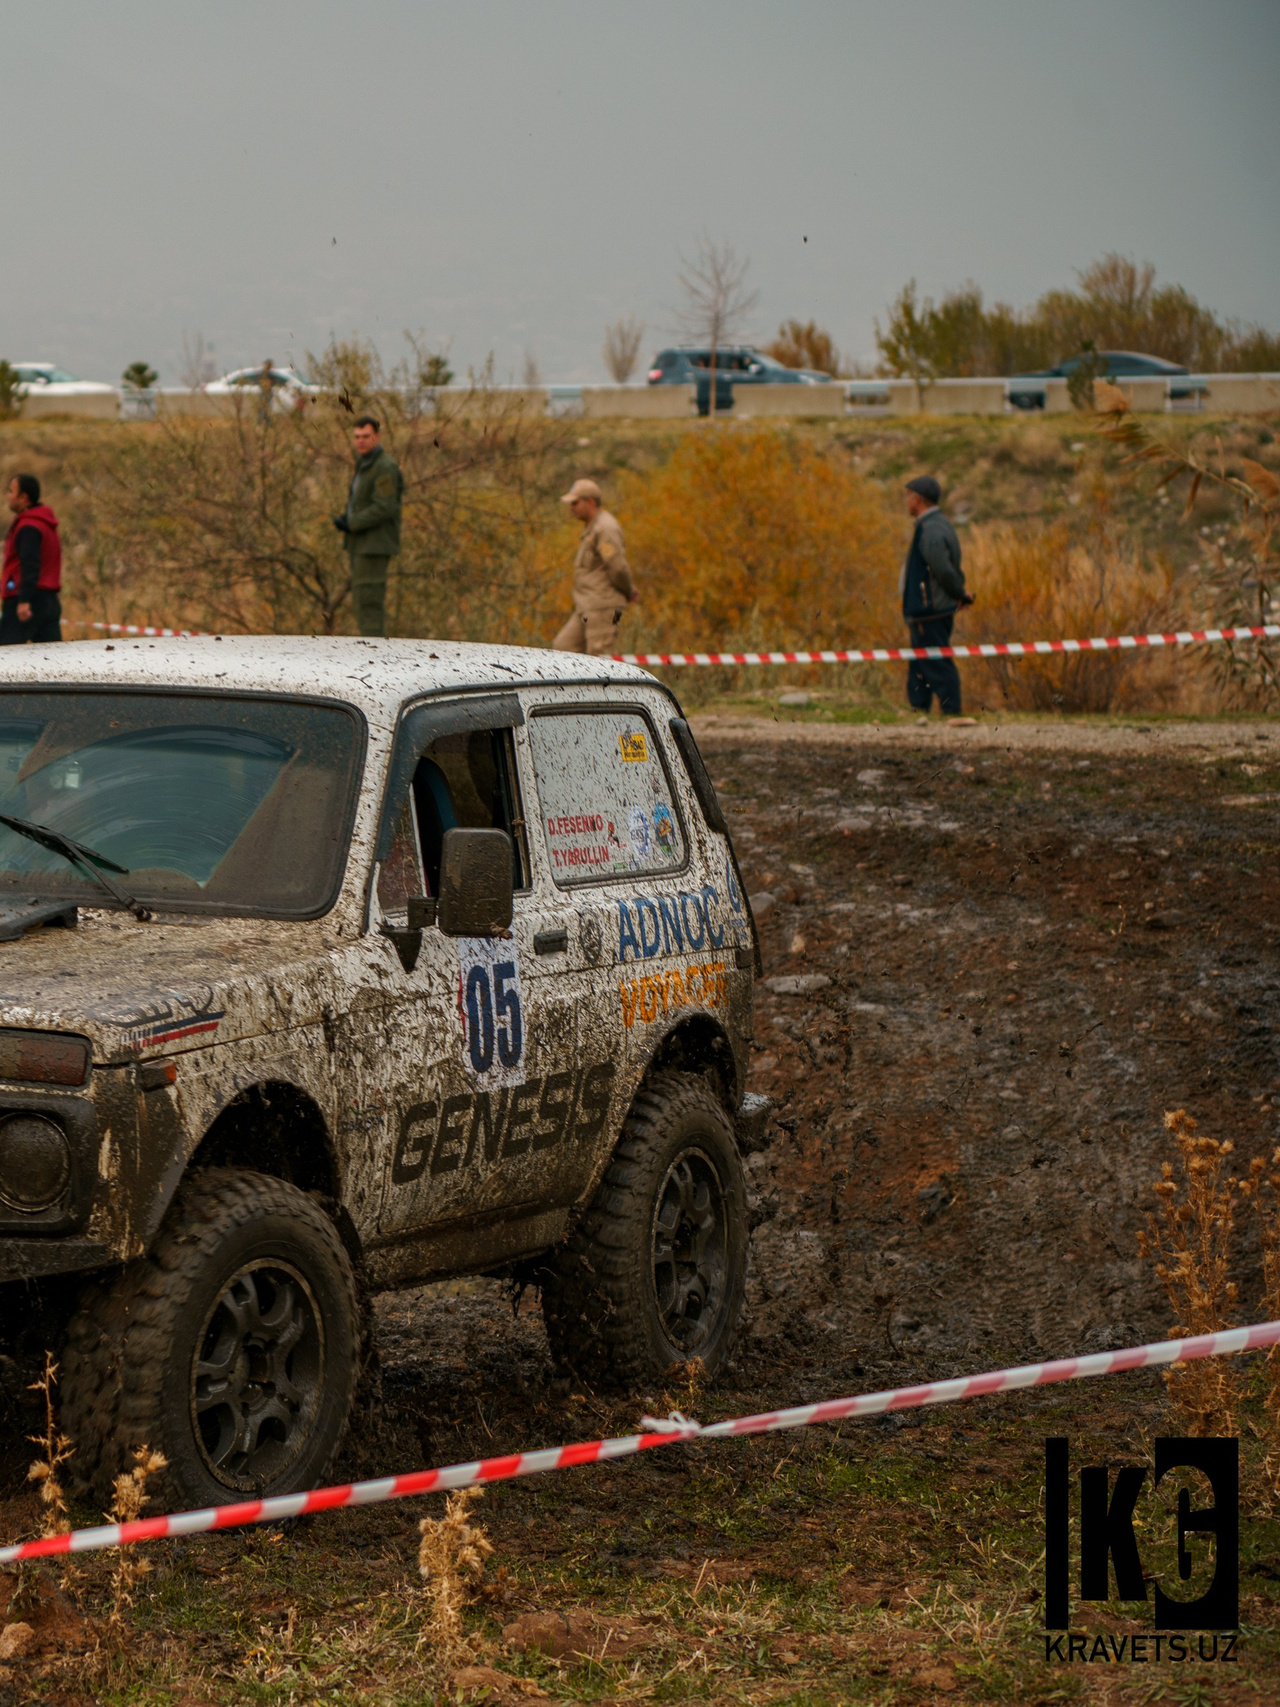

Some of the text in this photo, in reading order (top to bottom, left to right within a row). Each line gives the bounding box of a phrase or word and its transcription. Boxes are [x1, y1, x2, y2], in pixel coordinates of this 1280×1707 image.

[547, 814, 604, 836] D.FESENKO
[552, 845, 610, 867] T.YARULLIN
[618, 884, 725, 961] ADNOC
[467, 961, 522, 1073] 05
[392, 1059, 617, 1185] GENESIS
